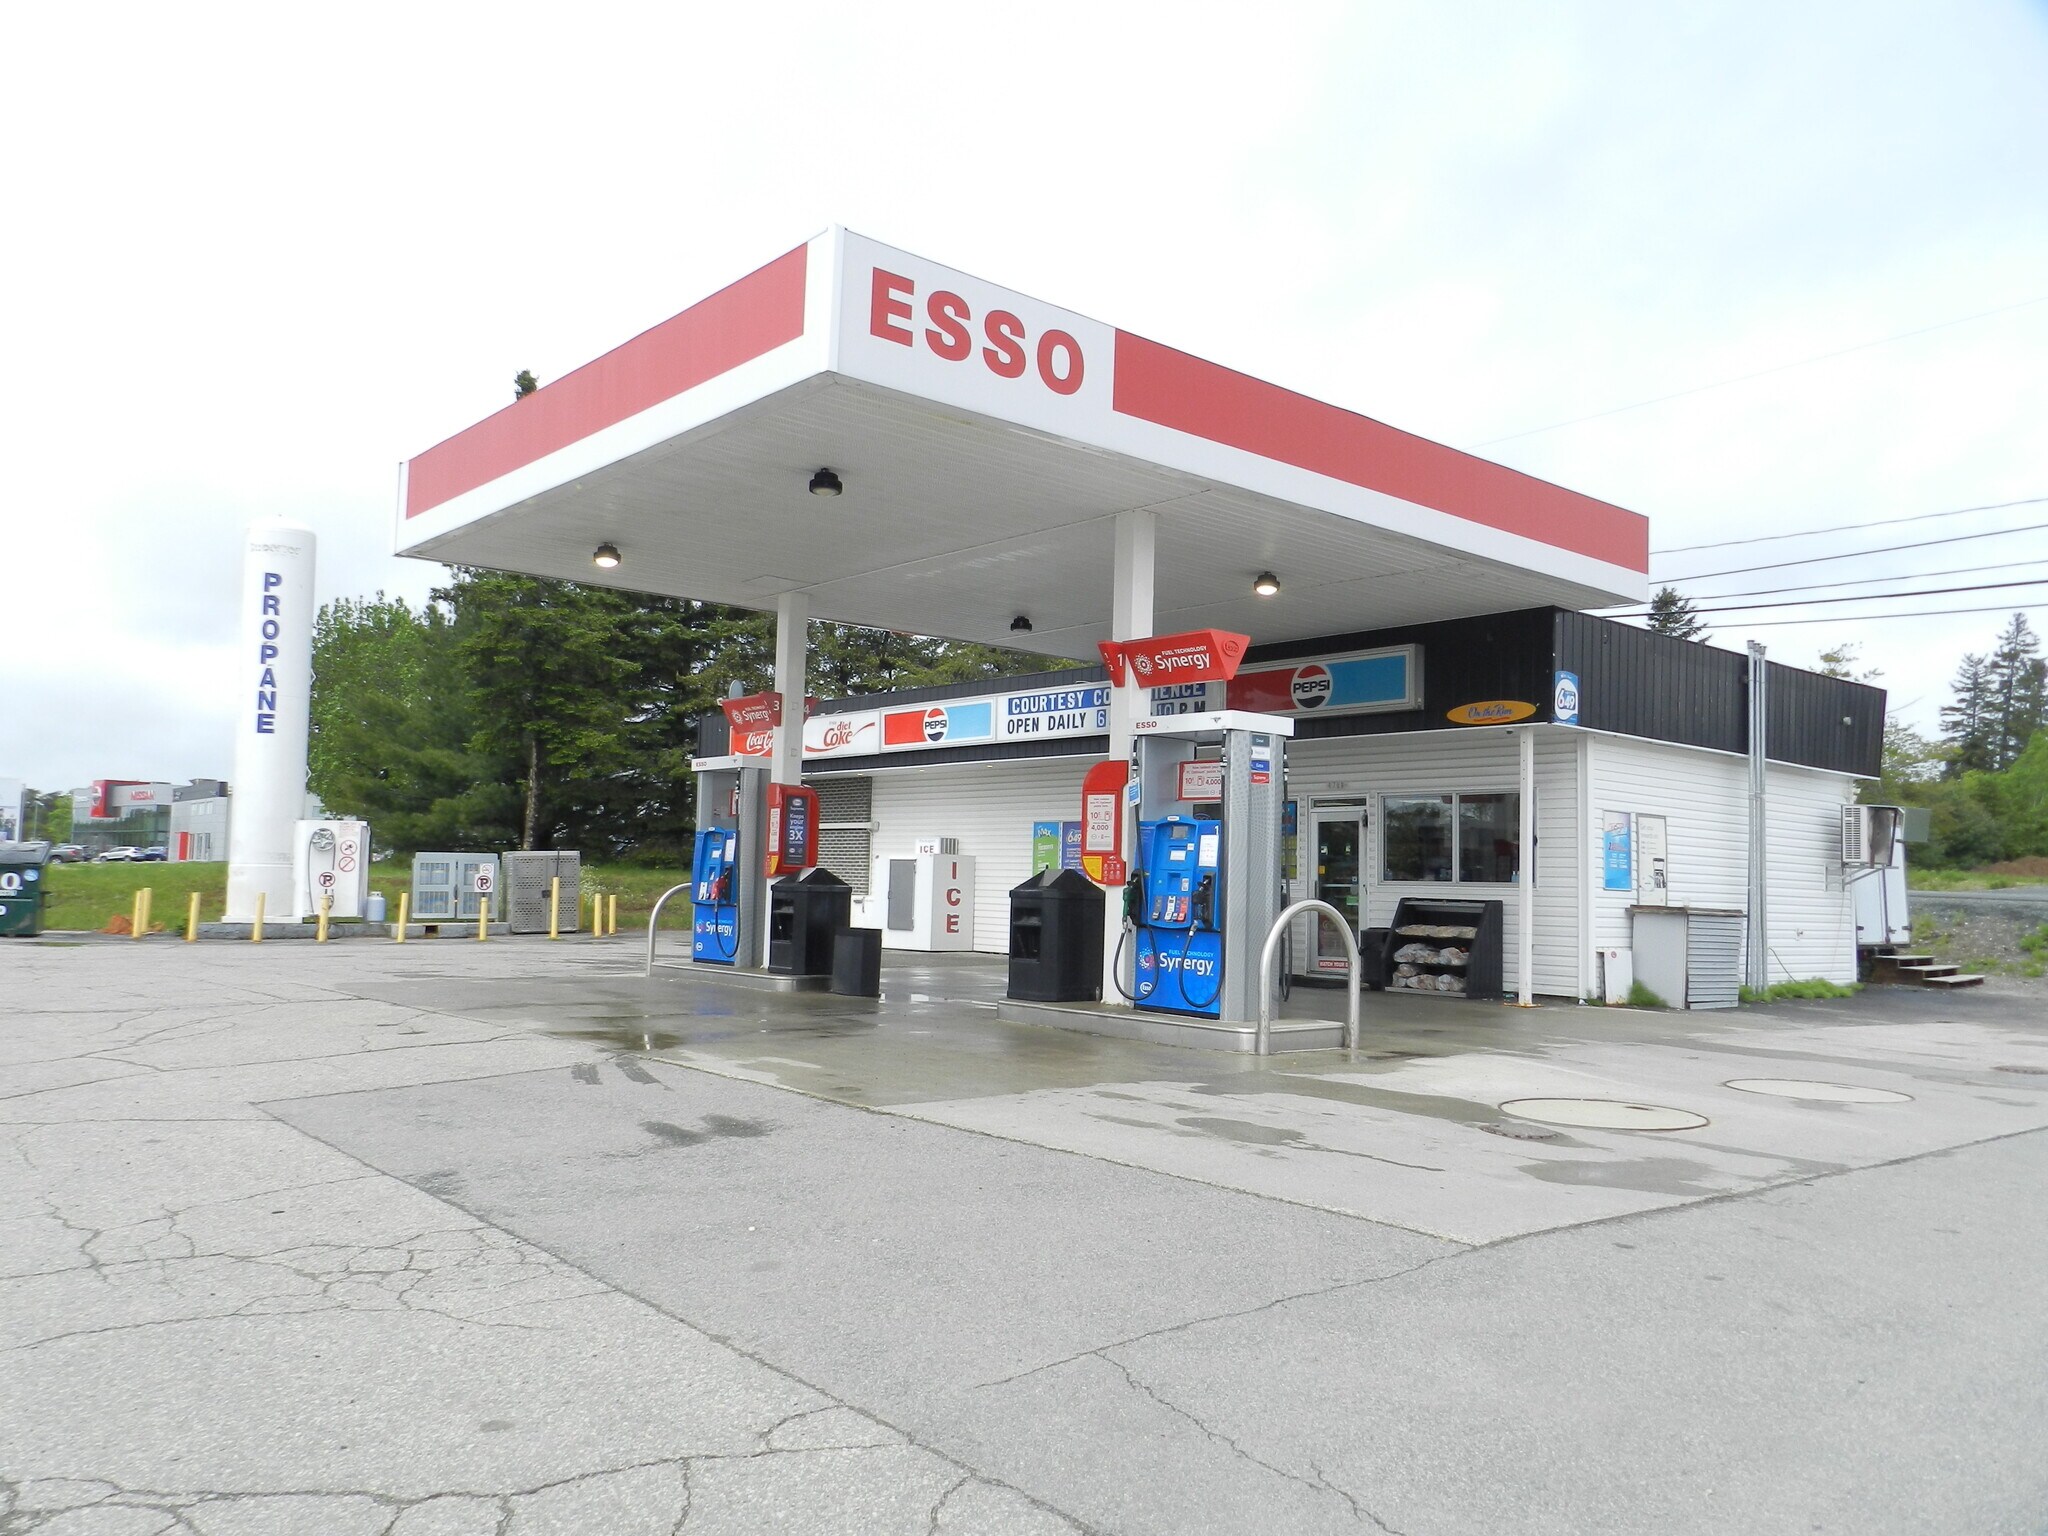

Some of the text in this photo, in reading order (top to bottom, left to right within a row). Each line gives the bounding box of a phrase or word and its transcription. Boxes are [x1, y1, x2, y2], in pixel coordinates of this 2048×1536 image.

[870, 267, 1085, 395] ESSO
[257, 572, 282, 734] PROPANE
[1174, 645, 1207, 654] TECHNOLOGY
[1117, 653, 1123, 667] 1
[1154, 653, 1210, 673] Synergy
[1293, 679, 1330, 694] PEPSI
[773, 700, 780, 710] 3
[1012, 691, 1085, 714] COURTESY
[837, 721, 852, 731] diet
[925, 720, 948, 730] PEPSI
[1007, 717, 1040, 734] OPEN
[1048, 713, 1087, 730] DAILY
[1097, 711, 1106, 726] 6
[1135, 721, 1157, 729] ESSO
[824, 727, 853, 748] Coke
[788, 830, 803, 840] 3X
[1214, 826, 1219, 835] 1
[920, 845, 934, 853] ICE
[946, 861, 961, 933] ICE
